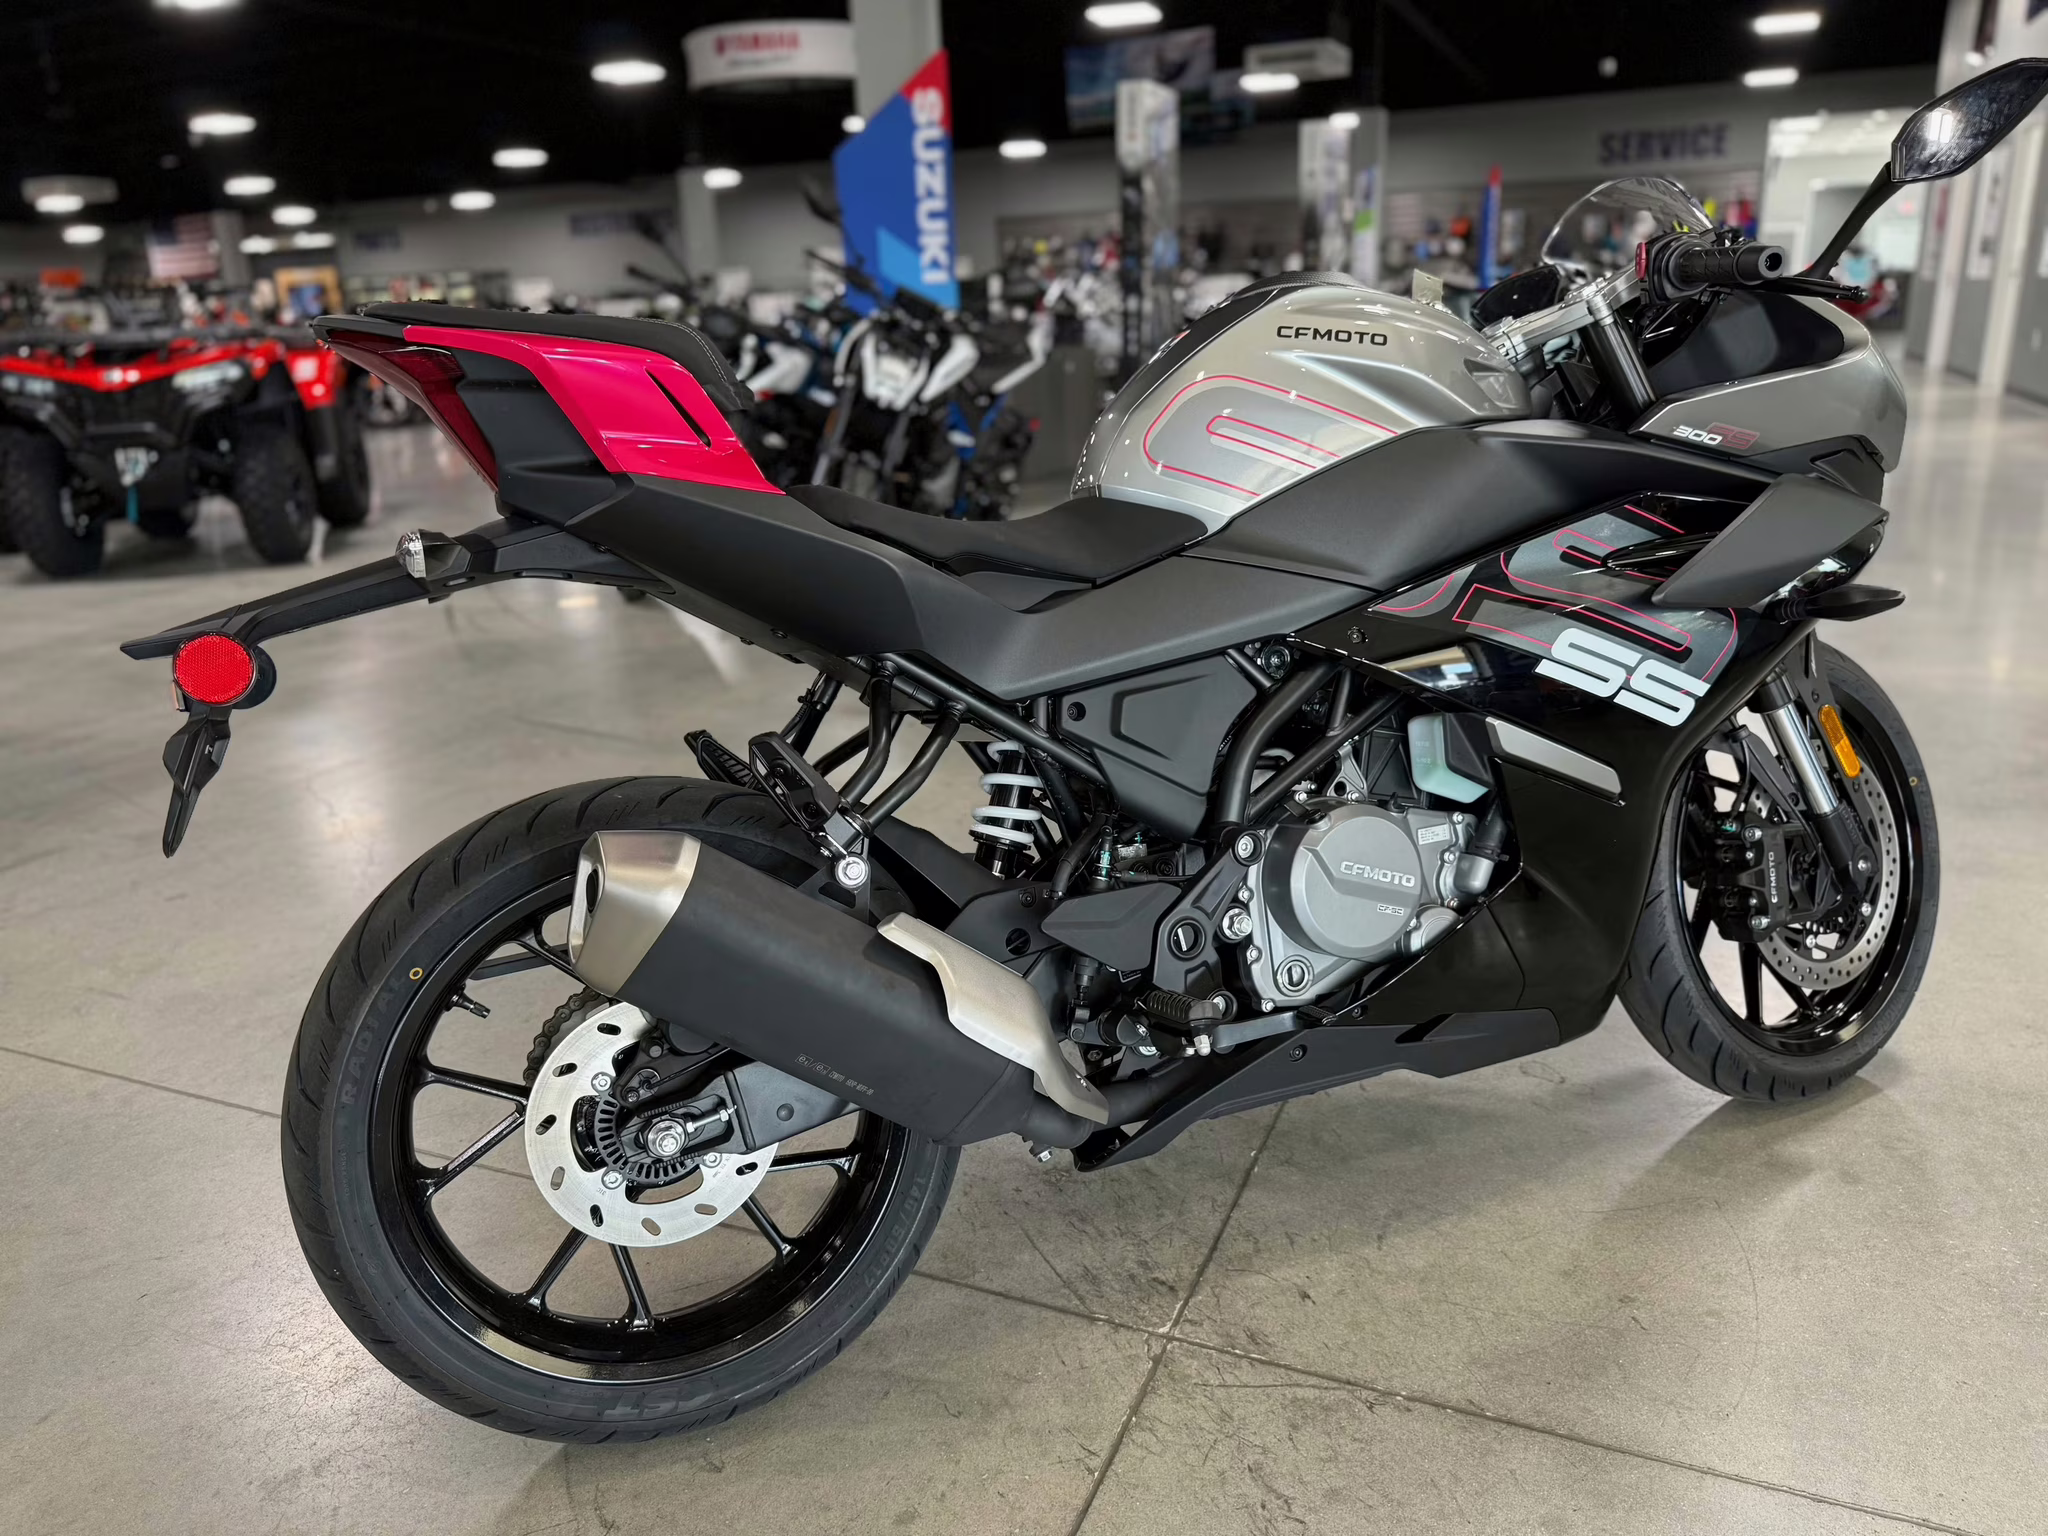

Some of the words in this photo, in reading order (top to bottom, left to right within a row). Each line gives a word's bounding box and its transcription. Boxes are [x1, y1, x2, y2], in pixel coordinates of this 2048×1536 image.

[1598, 122, 1731, 167] SERVICE
[911, 87, 950, 284] SUZUKI
[1276, 325, 1388, 346] CFMOTO
[1534, 627, 1712, 727] SS
[1340, 861, 1416, 888] CFMOTO
[1768, 852, 1779, 904] CFMOTO
[341, 974, 406, 1105] RADIAL
